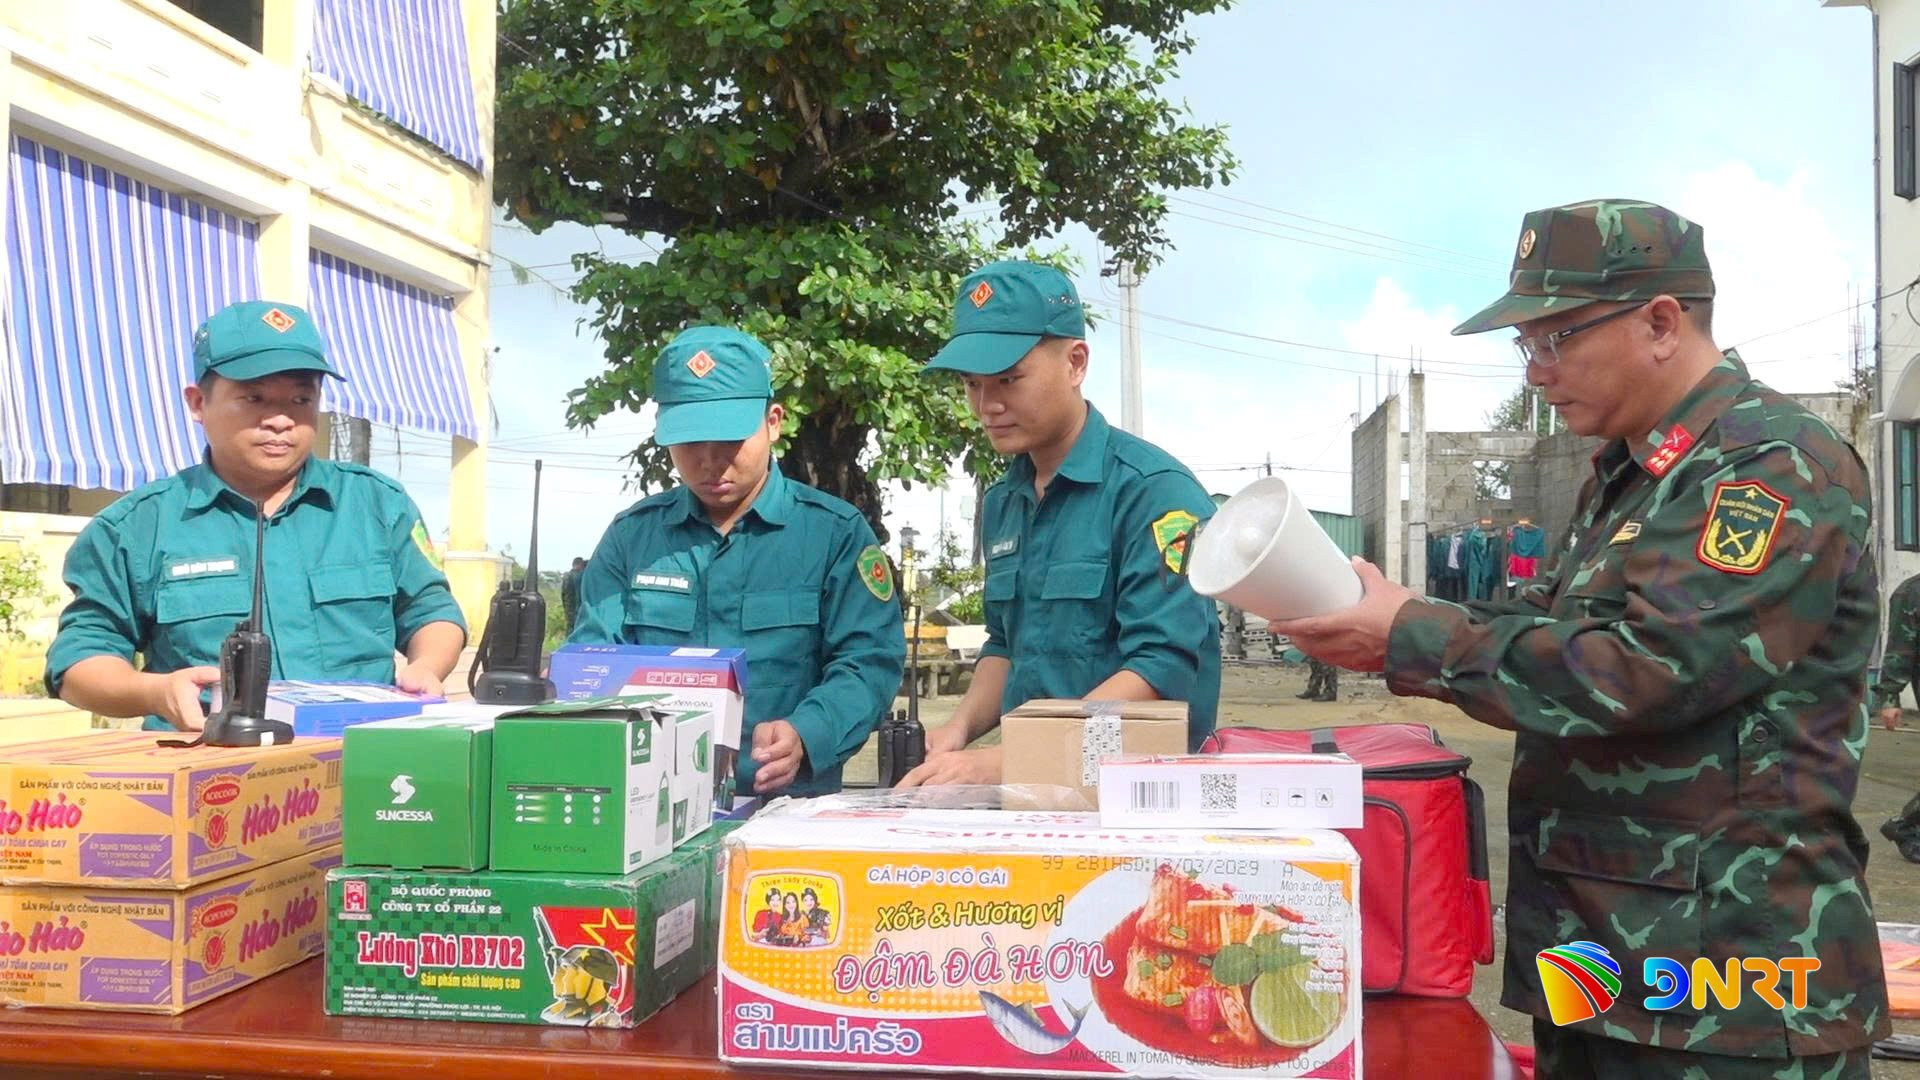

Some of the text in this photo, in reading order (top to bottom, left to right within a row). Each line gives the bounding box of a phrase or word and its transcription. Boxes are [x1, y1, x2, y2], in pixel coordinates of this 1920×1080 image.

[20, 780, 36, 789] SẢN
[37, 779, 59, 789] PHẨM
[61, 780, 75, 789] VỚI
[76, 780, 99, 790] CÔNG
[0, 792, 82, 835] ảo Hảo
[241, 793, 280, 846] Hảo
[282, 776, 320, 826] Hảo
[375, 809, 433, 822] SUNCESSA
[868, 864, 1006, 887] CÁ HỘP 3 CÔ GÁI
[391, 882, 492, 899] BỘ QUỐC PHÒNG
[21, 902, 37, 911] SẢN
[39, 901, 60, 912] PHẨM
[61, 903, 75, 912] VỚI
[76, 904, 99, 913] CÔNG
[382, 899, 413, 912] CÔNG
[416, 903, 432, 912] TY
[453, 899, 486, 913] PHẦN
[489, 905, 502, 914] 22
[876, 894, 1065, 932] Xốt & Hương vị
[0, 915, 85, 956] ảo Hảo
[239, 908, 280, 963] Hảo
[281, 886, 318, 938] Hảo
[419, 933, 457, 967] Khô
[459, 935, 525, 969] BB702
[505, 977, 521, 989] cao
[736, 1003, 773, 1019] ตรา
[735, 1017, 921, 1055] สามแม่ครัว
[1068, 1050, 1124, 1064] MACKEREL
[1126, 1051, 1137, 1064] IN
[1139, 1051, 1182, 1065] TOMATO
[1287, 1057, 1309, 1070] 100
[1313, 1060, 1344, 1072] cans
